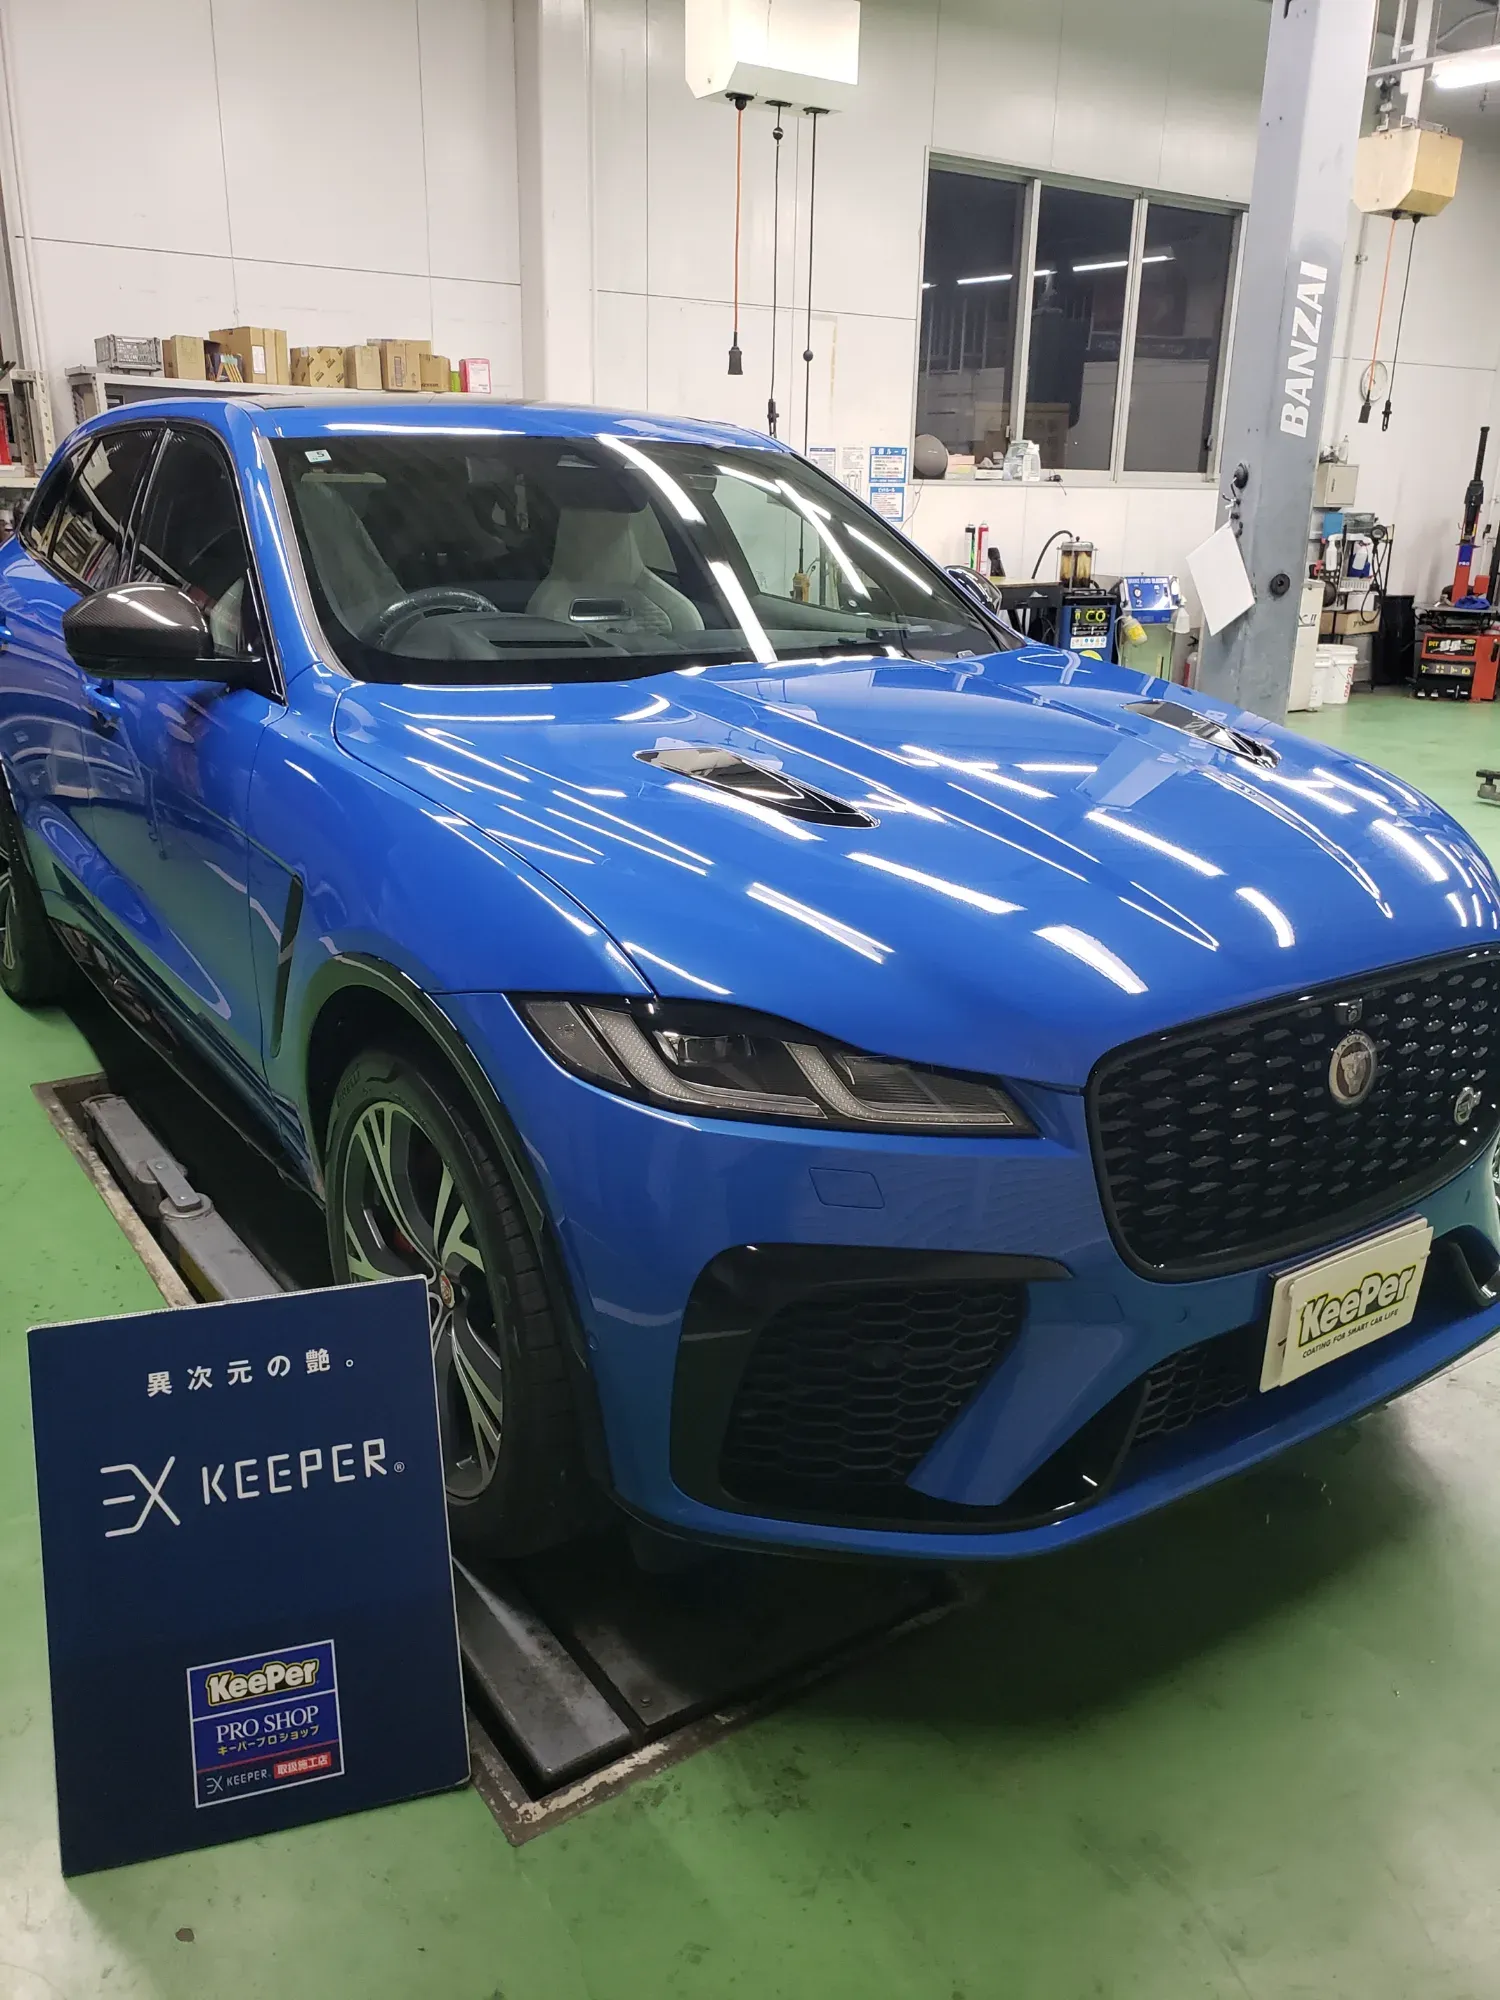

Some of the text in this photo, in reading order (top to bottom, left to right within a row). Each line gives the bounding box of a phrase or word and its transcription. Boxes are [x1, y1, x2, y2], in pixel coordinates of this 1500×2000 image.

[1279, 260, 1328, 439] BANZAI
[1298, 1265, 1417, 1348] KeePer
[1302, 1308, 1399, 1358] COATING FOR SMART CAR LIFE
[207, 1659, 318, 1705] KeePer
[216, 1705, 319, 1744] PRO SHOP
[217, 1725, 320, 1756] キーパープロショップ
